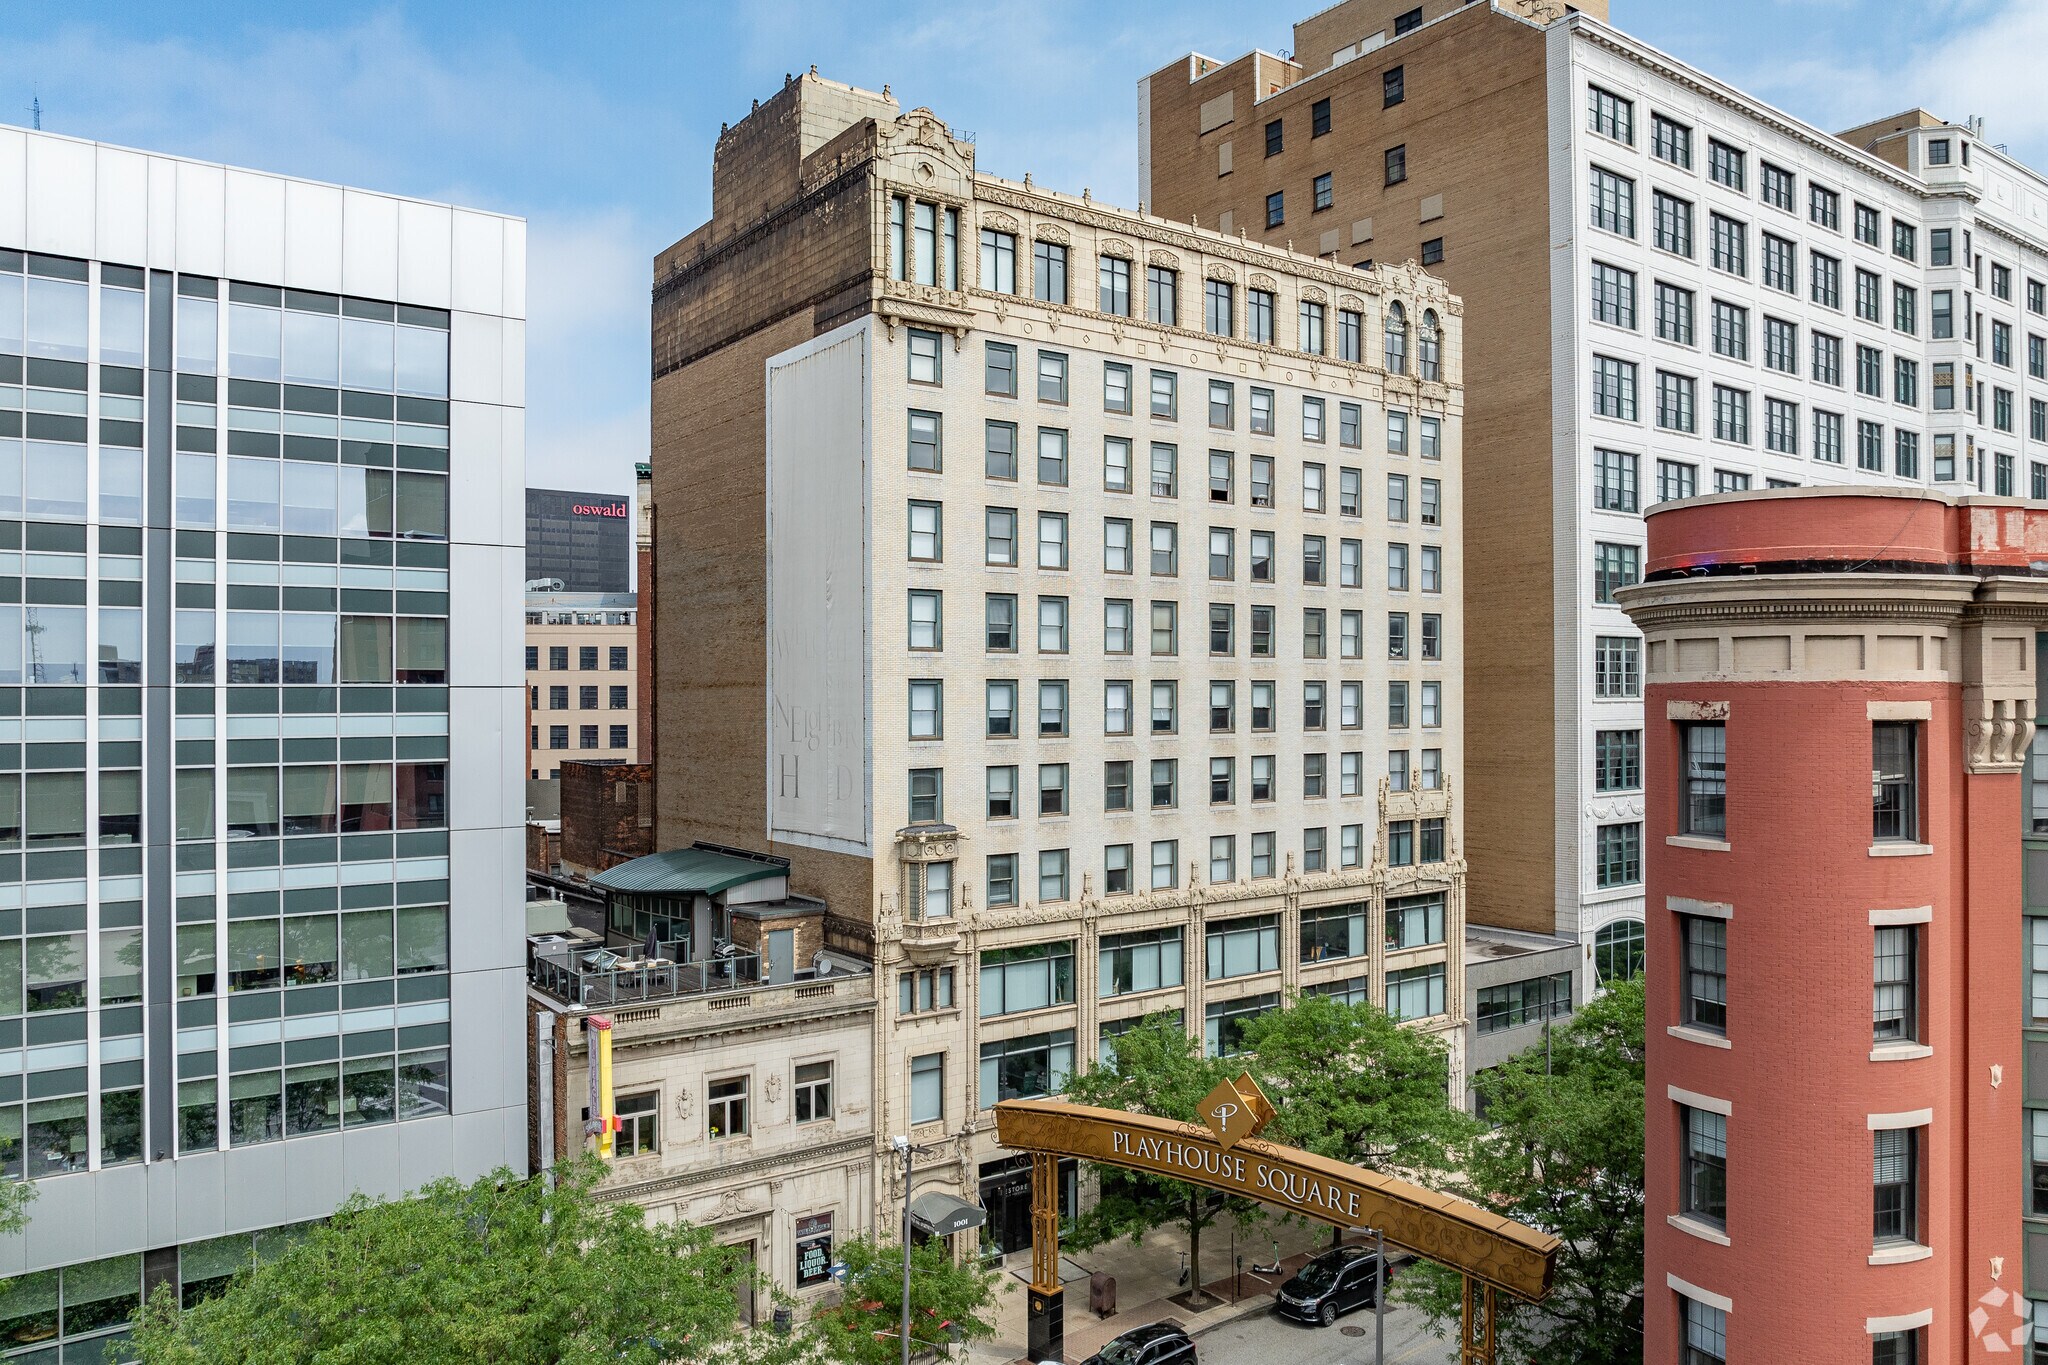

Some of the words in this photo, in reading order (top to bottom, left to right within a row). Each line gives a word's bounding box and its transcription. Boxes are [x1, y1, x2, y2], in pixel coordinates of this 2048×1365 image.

[573, 503, 627, 518] oswald
[1112, 1130, 1247, 1183] PLAYHOUSE
[1256, 1164, 1361, 1219] SQUARE
[953, 1218, 969, 1228] 1001
[804, 1247, 824, 1260] FOOD.
[800, 1258, 829, 1270] LIQUOR.
[803, 1266, 825, 1278] BEER.
